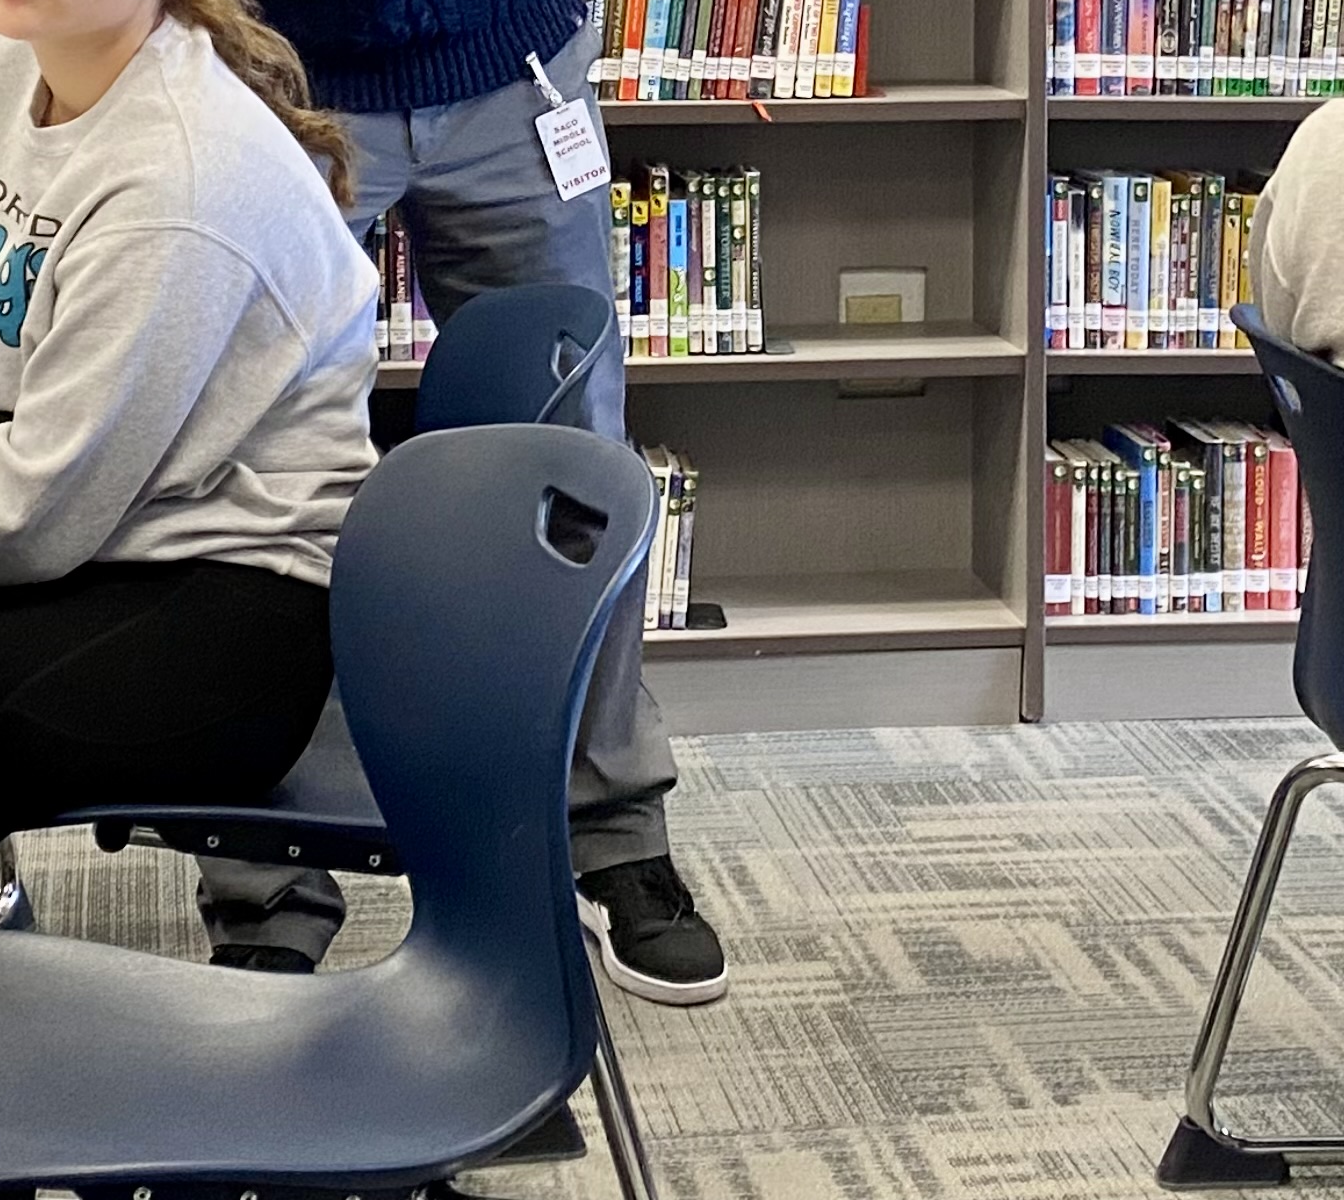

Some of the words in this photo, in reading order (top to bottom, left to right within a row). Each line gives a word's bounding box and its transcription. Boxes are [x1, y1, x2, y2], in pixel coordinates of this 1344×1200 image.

[553, 128, 587, 146] MIDDLE
[554, 118, 578, 134] SACO
[555, 138, 592, 158] SCHOOL
[561, 166, 607, 191] VISITOR
[1130, 219, 1140, 251] HERE
[720, 225, 730, 299] STORYTELLER
[1109, 269, 1120, 293] BOY
[1130, 257, 1140, 294] TODAY
[1254, 465, 1264, 505] CLOUD
